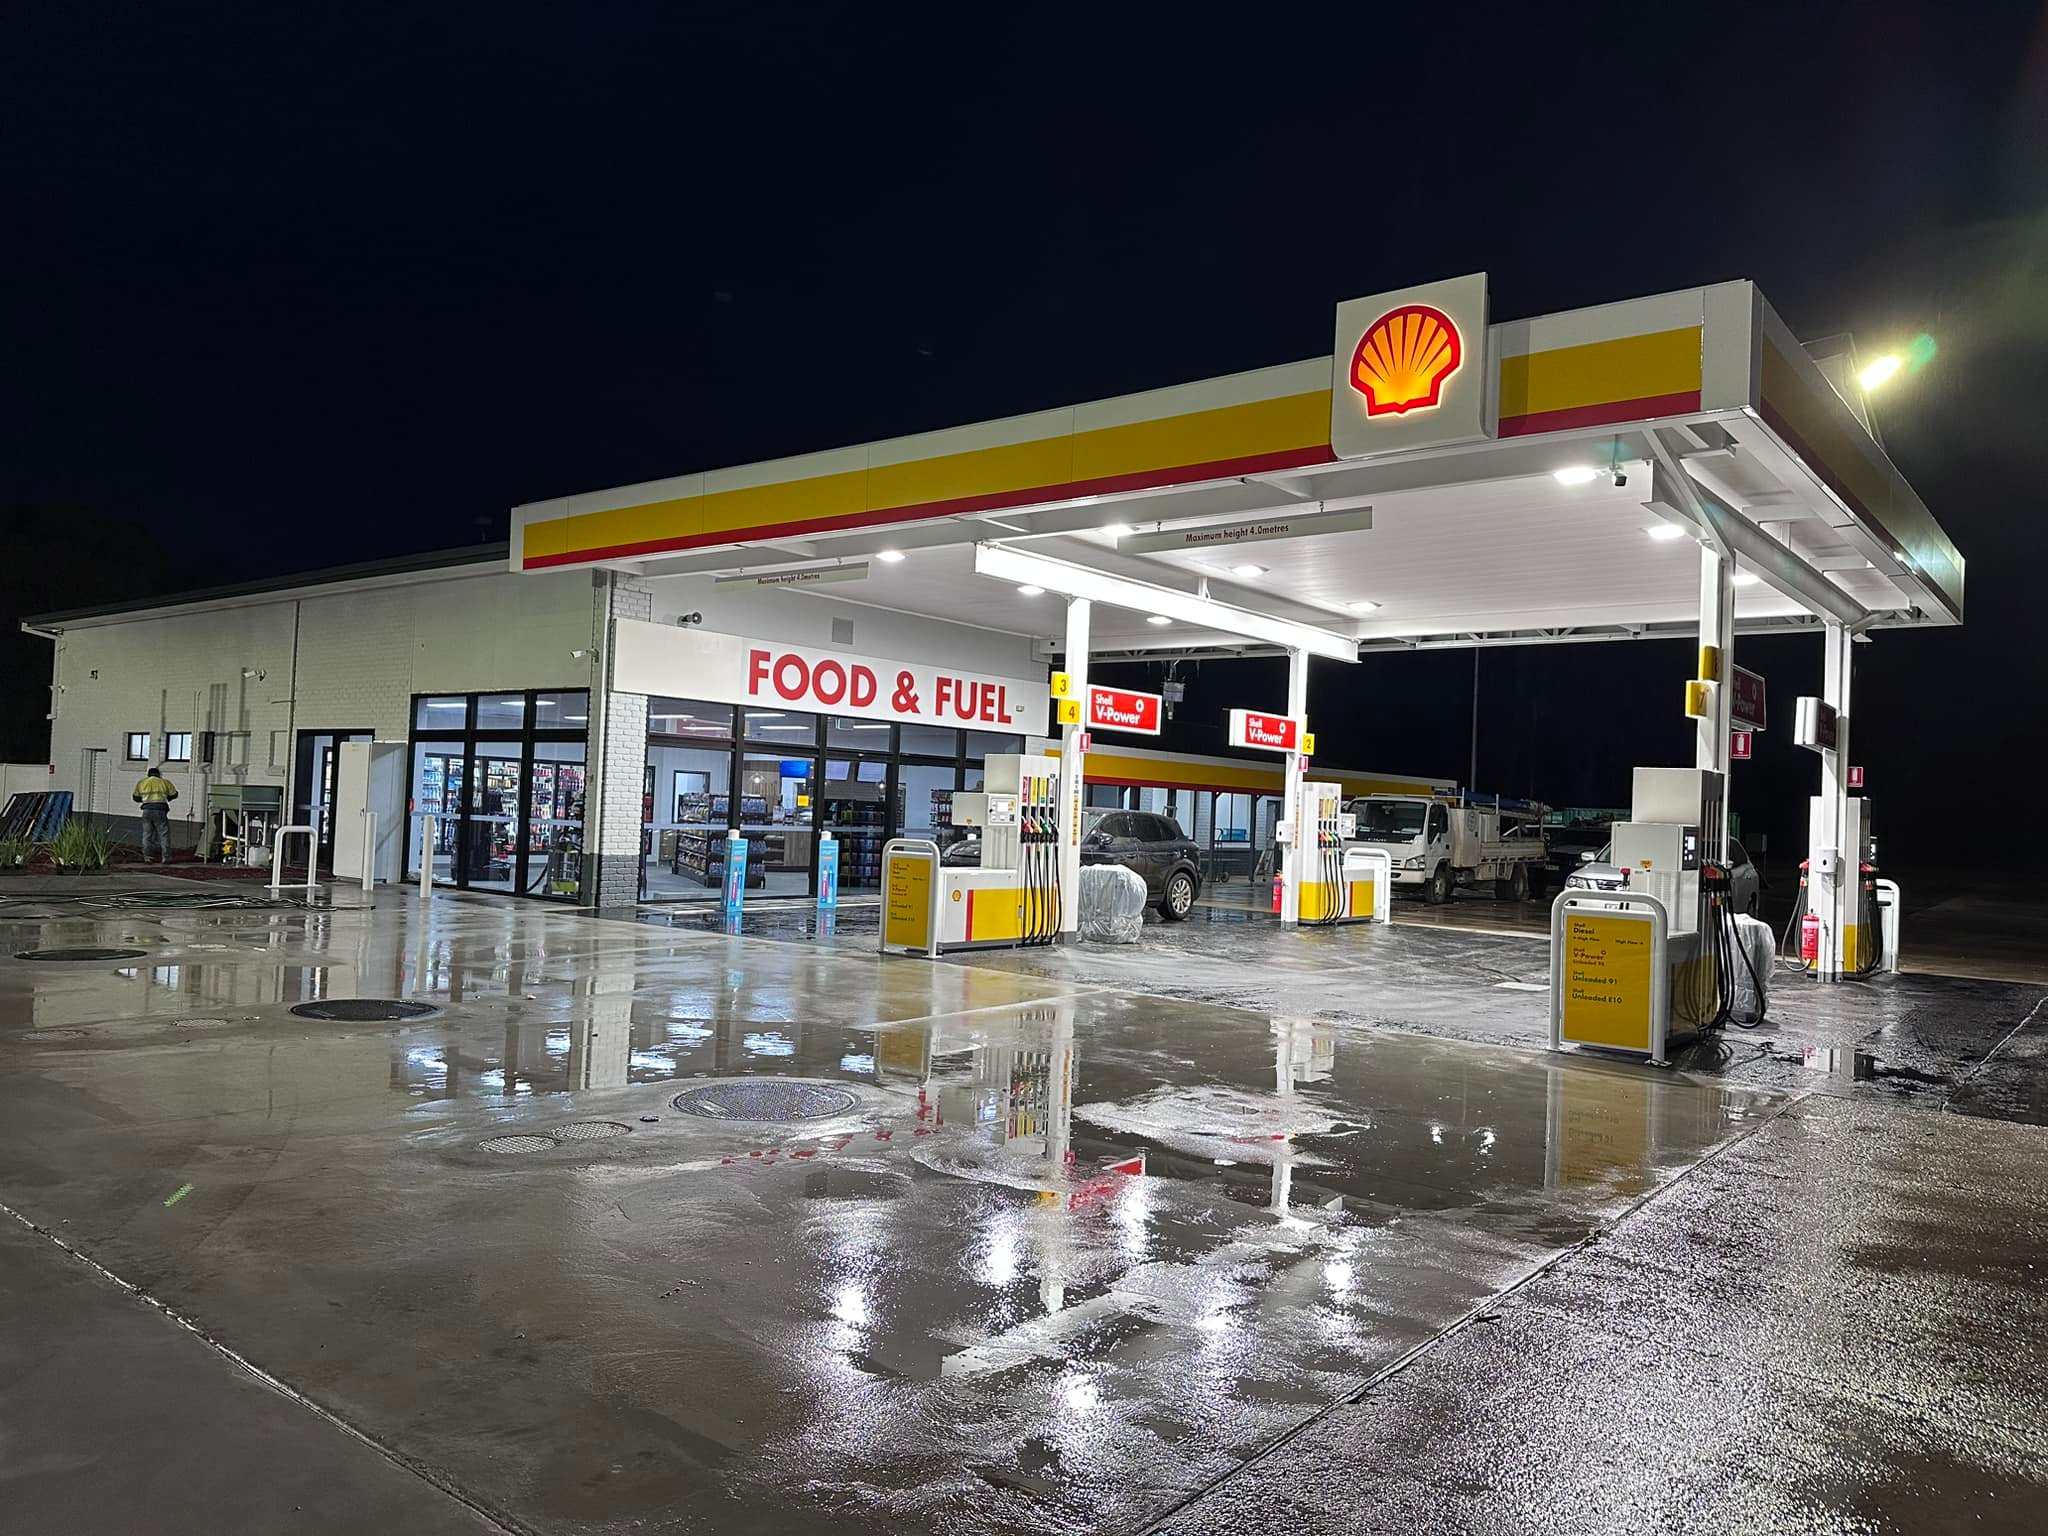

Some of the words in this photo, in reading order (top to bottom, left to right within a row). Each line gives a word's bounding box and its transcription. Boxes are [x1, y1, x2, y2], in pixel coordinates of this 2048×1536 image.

[1185, 532, 1222, 543] Maximum
[1223, 528, 1248, 540] height
[1249, 525, 1289, 535] 4.0metres
[748, 649, 877, 708] FOOD
[891, 670, 921, 714] &
[935, 676, 1012, 724] FUEL
[1060, 679, 1067, 692] 3
[1095, 694, 1113, 706] Shell
[1068, 706, 1075, 719] 4
[1095, 705, 1141, 725] V-Power
[1248, 717, 1263, 728] Shell
[1248, 727, 1284, 745] V-Power
[1305, 738, 1312, 749] 2
[1573, 951, 1604, 960] V-Power
[1572, 975, 1607, 984] Unleaded
[1572, 993, 1607, 1002] Unleaded
